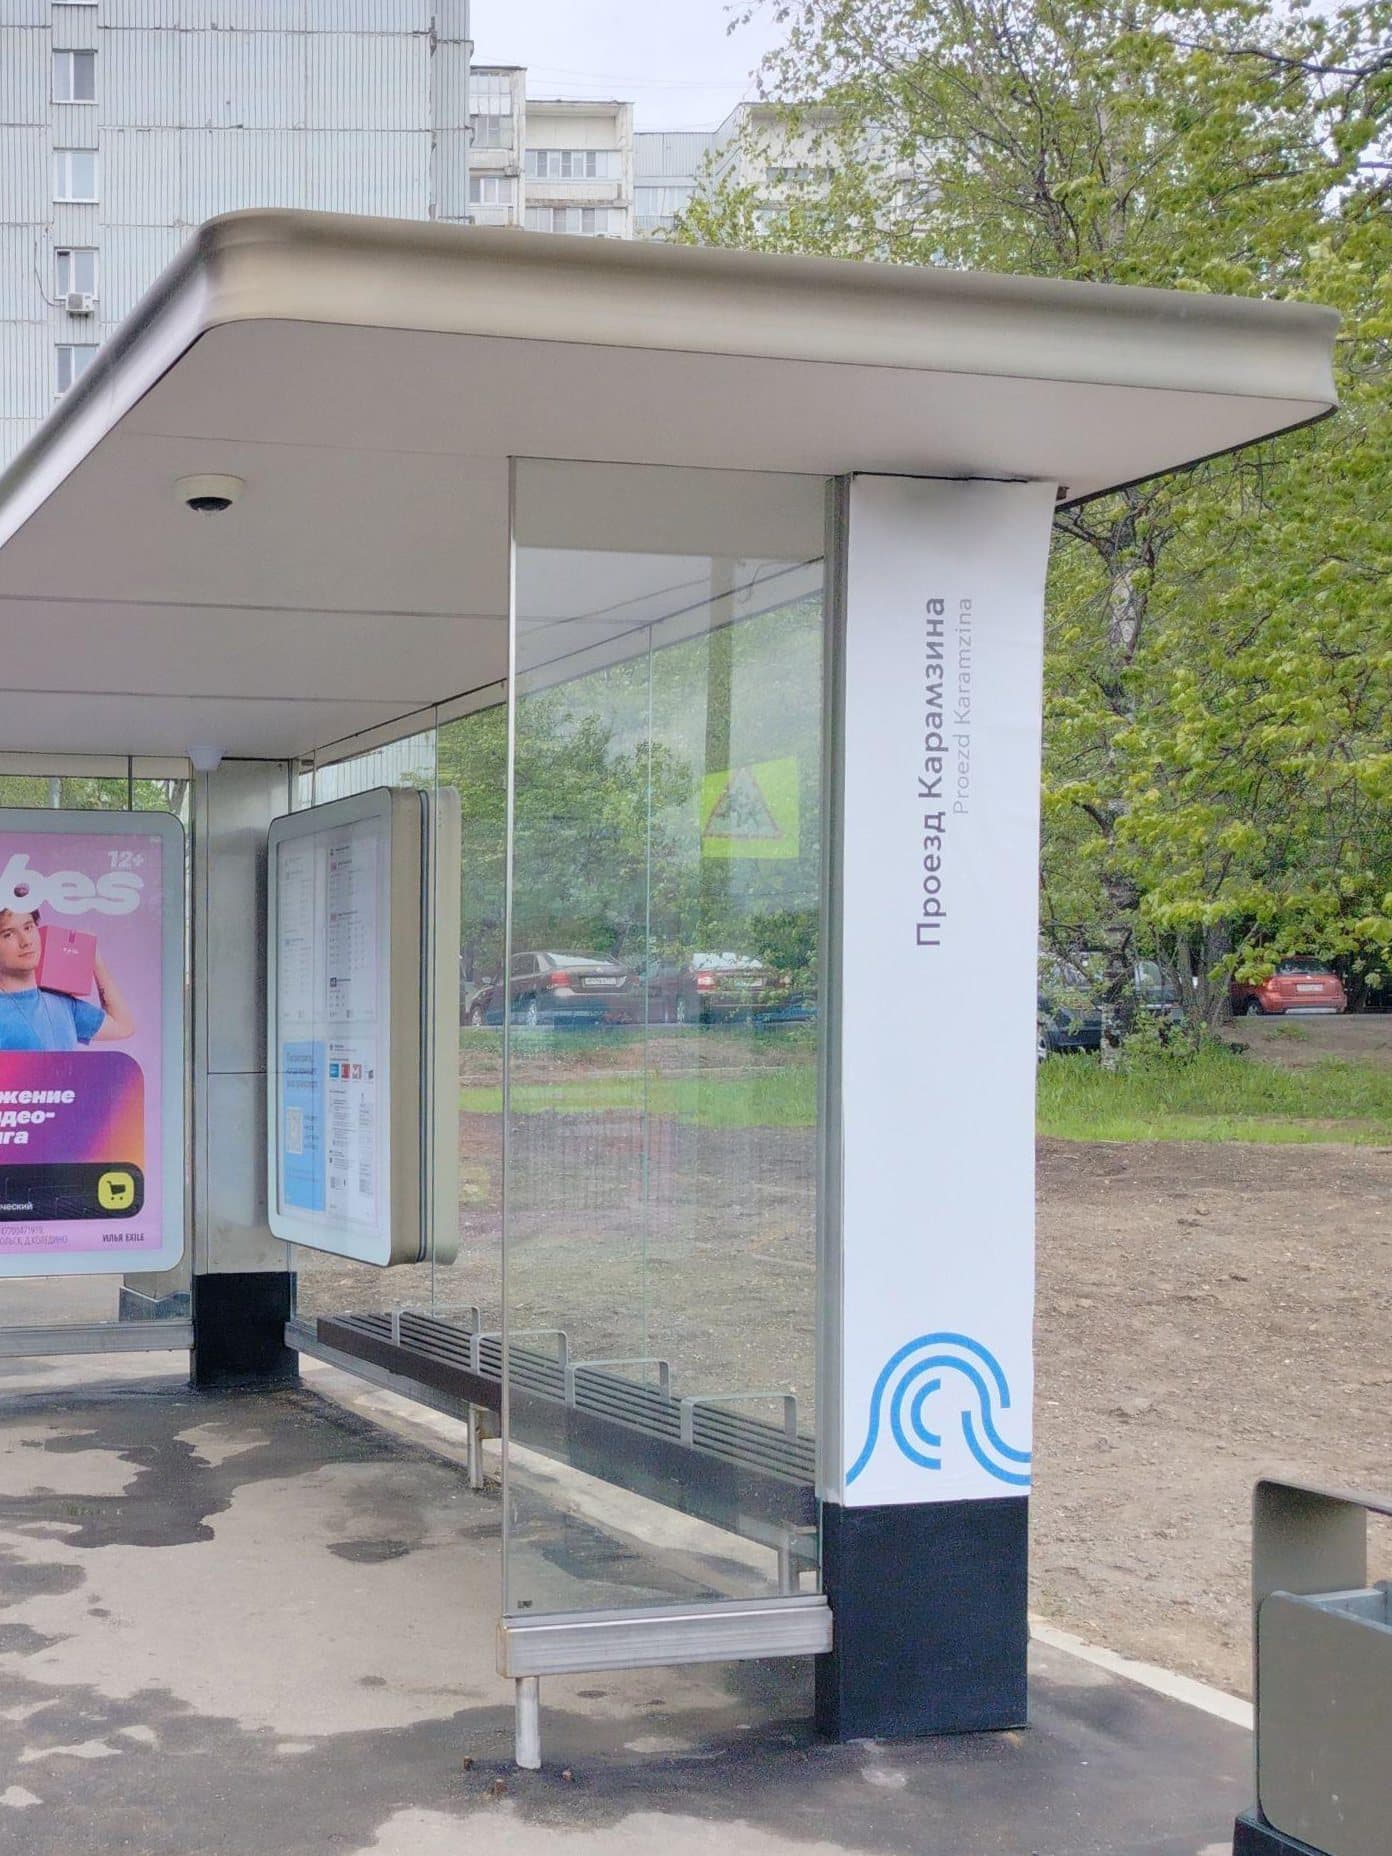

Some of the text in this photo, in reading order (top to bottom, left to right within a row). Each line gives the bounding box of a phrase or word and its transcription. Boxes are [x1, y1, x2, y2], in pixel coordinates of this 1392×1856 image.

[952, 597, 972, 815] Proezd Karamzina
[916, 597, 949, 947] Проезд Карамзина
[107, 850, 145, 868] 12+
[102, 1233, 145, 1243] ИЛЬЯ EXILE
